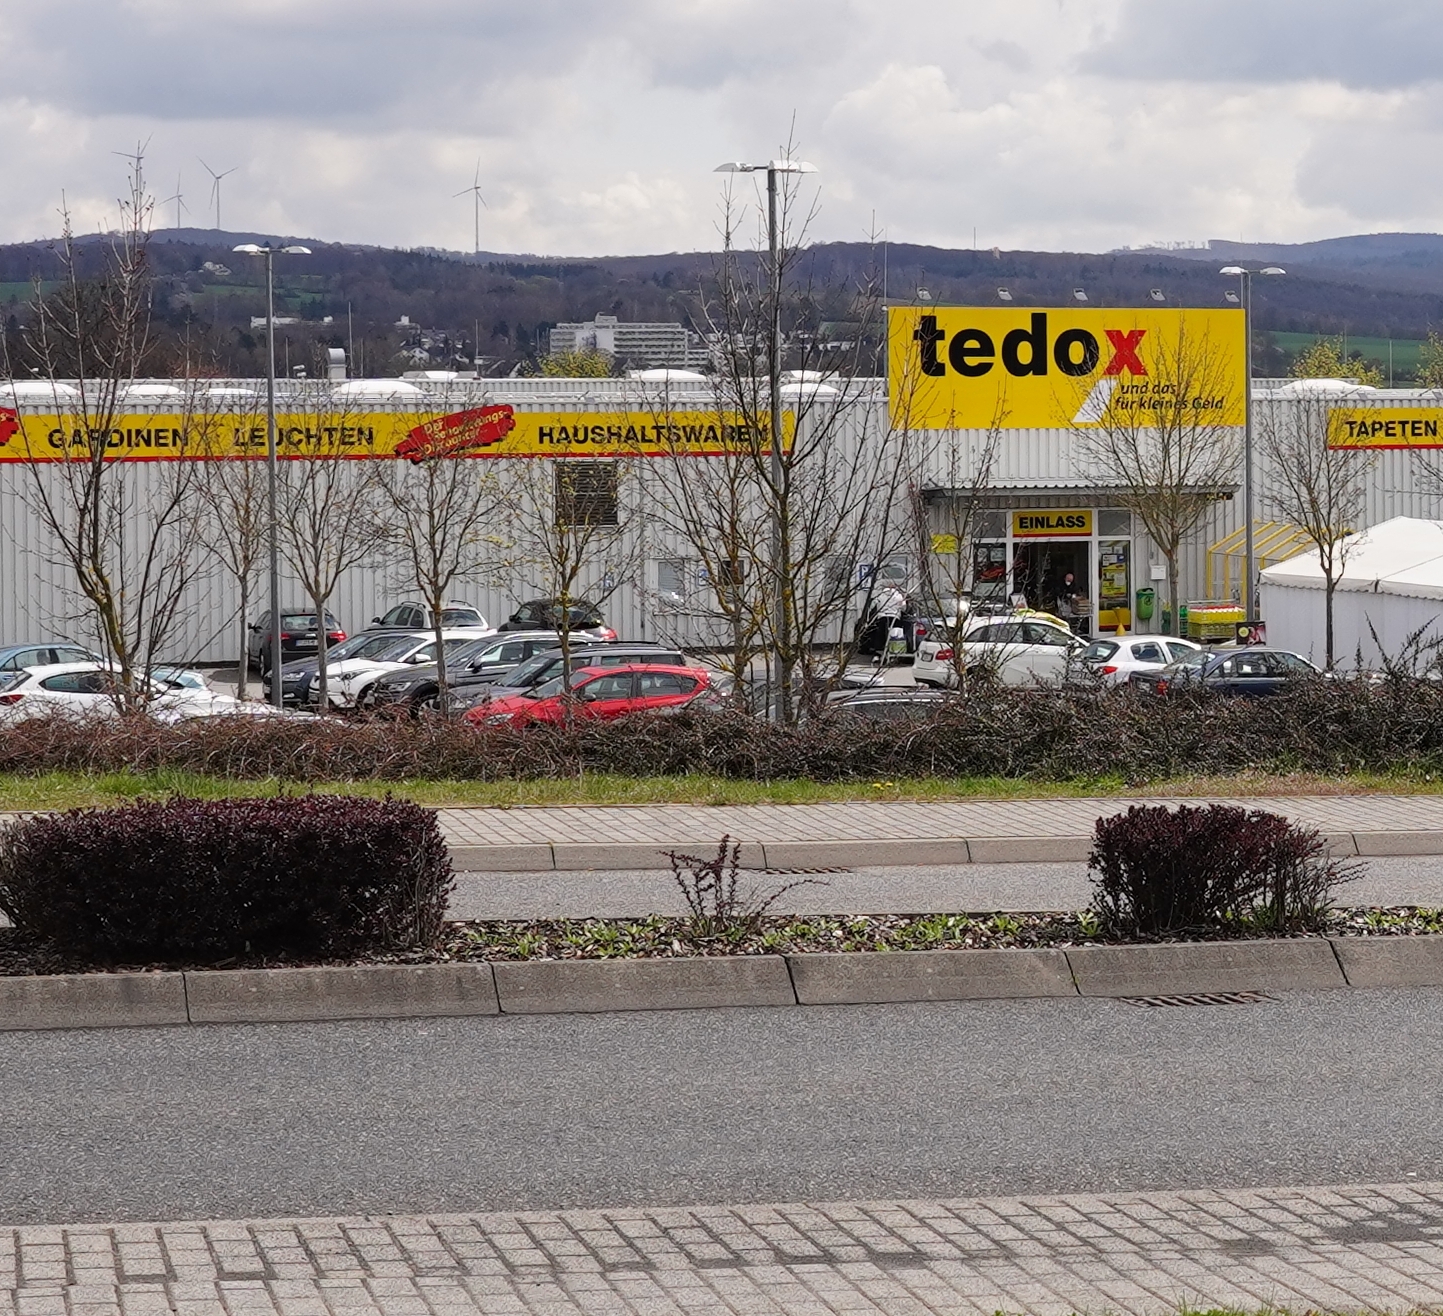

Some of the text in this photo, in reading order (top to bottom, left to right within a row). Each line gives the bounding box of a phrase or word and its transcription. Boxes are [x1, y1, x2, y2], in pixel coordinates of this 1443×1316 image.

[913, 312, 1149, 377] tedox
[1121, 381, 1149, 395] und
[1192, 396, 1225, 410] Geld
[1344, 420, 1438, 438] TAPETEN
[48, 428, 189, 449] GARDINEN
[1018, 515, 1086, 530] EINLASS
